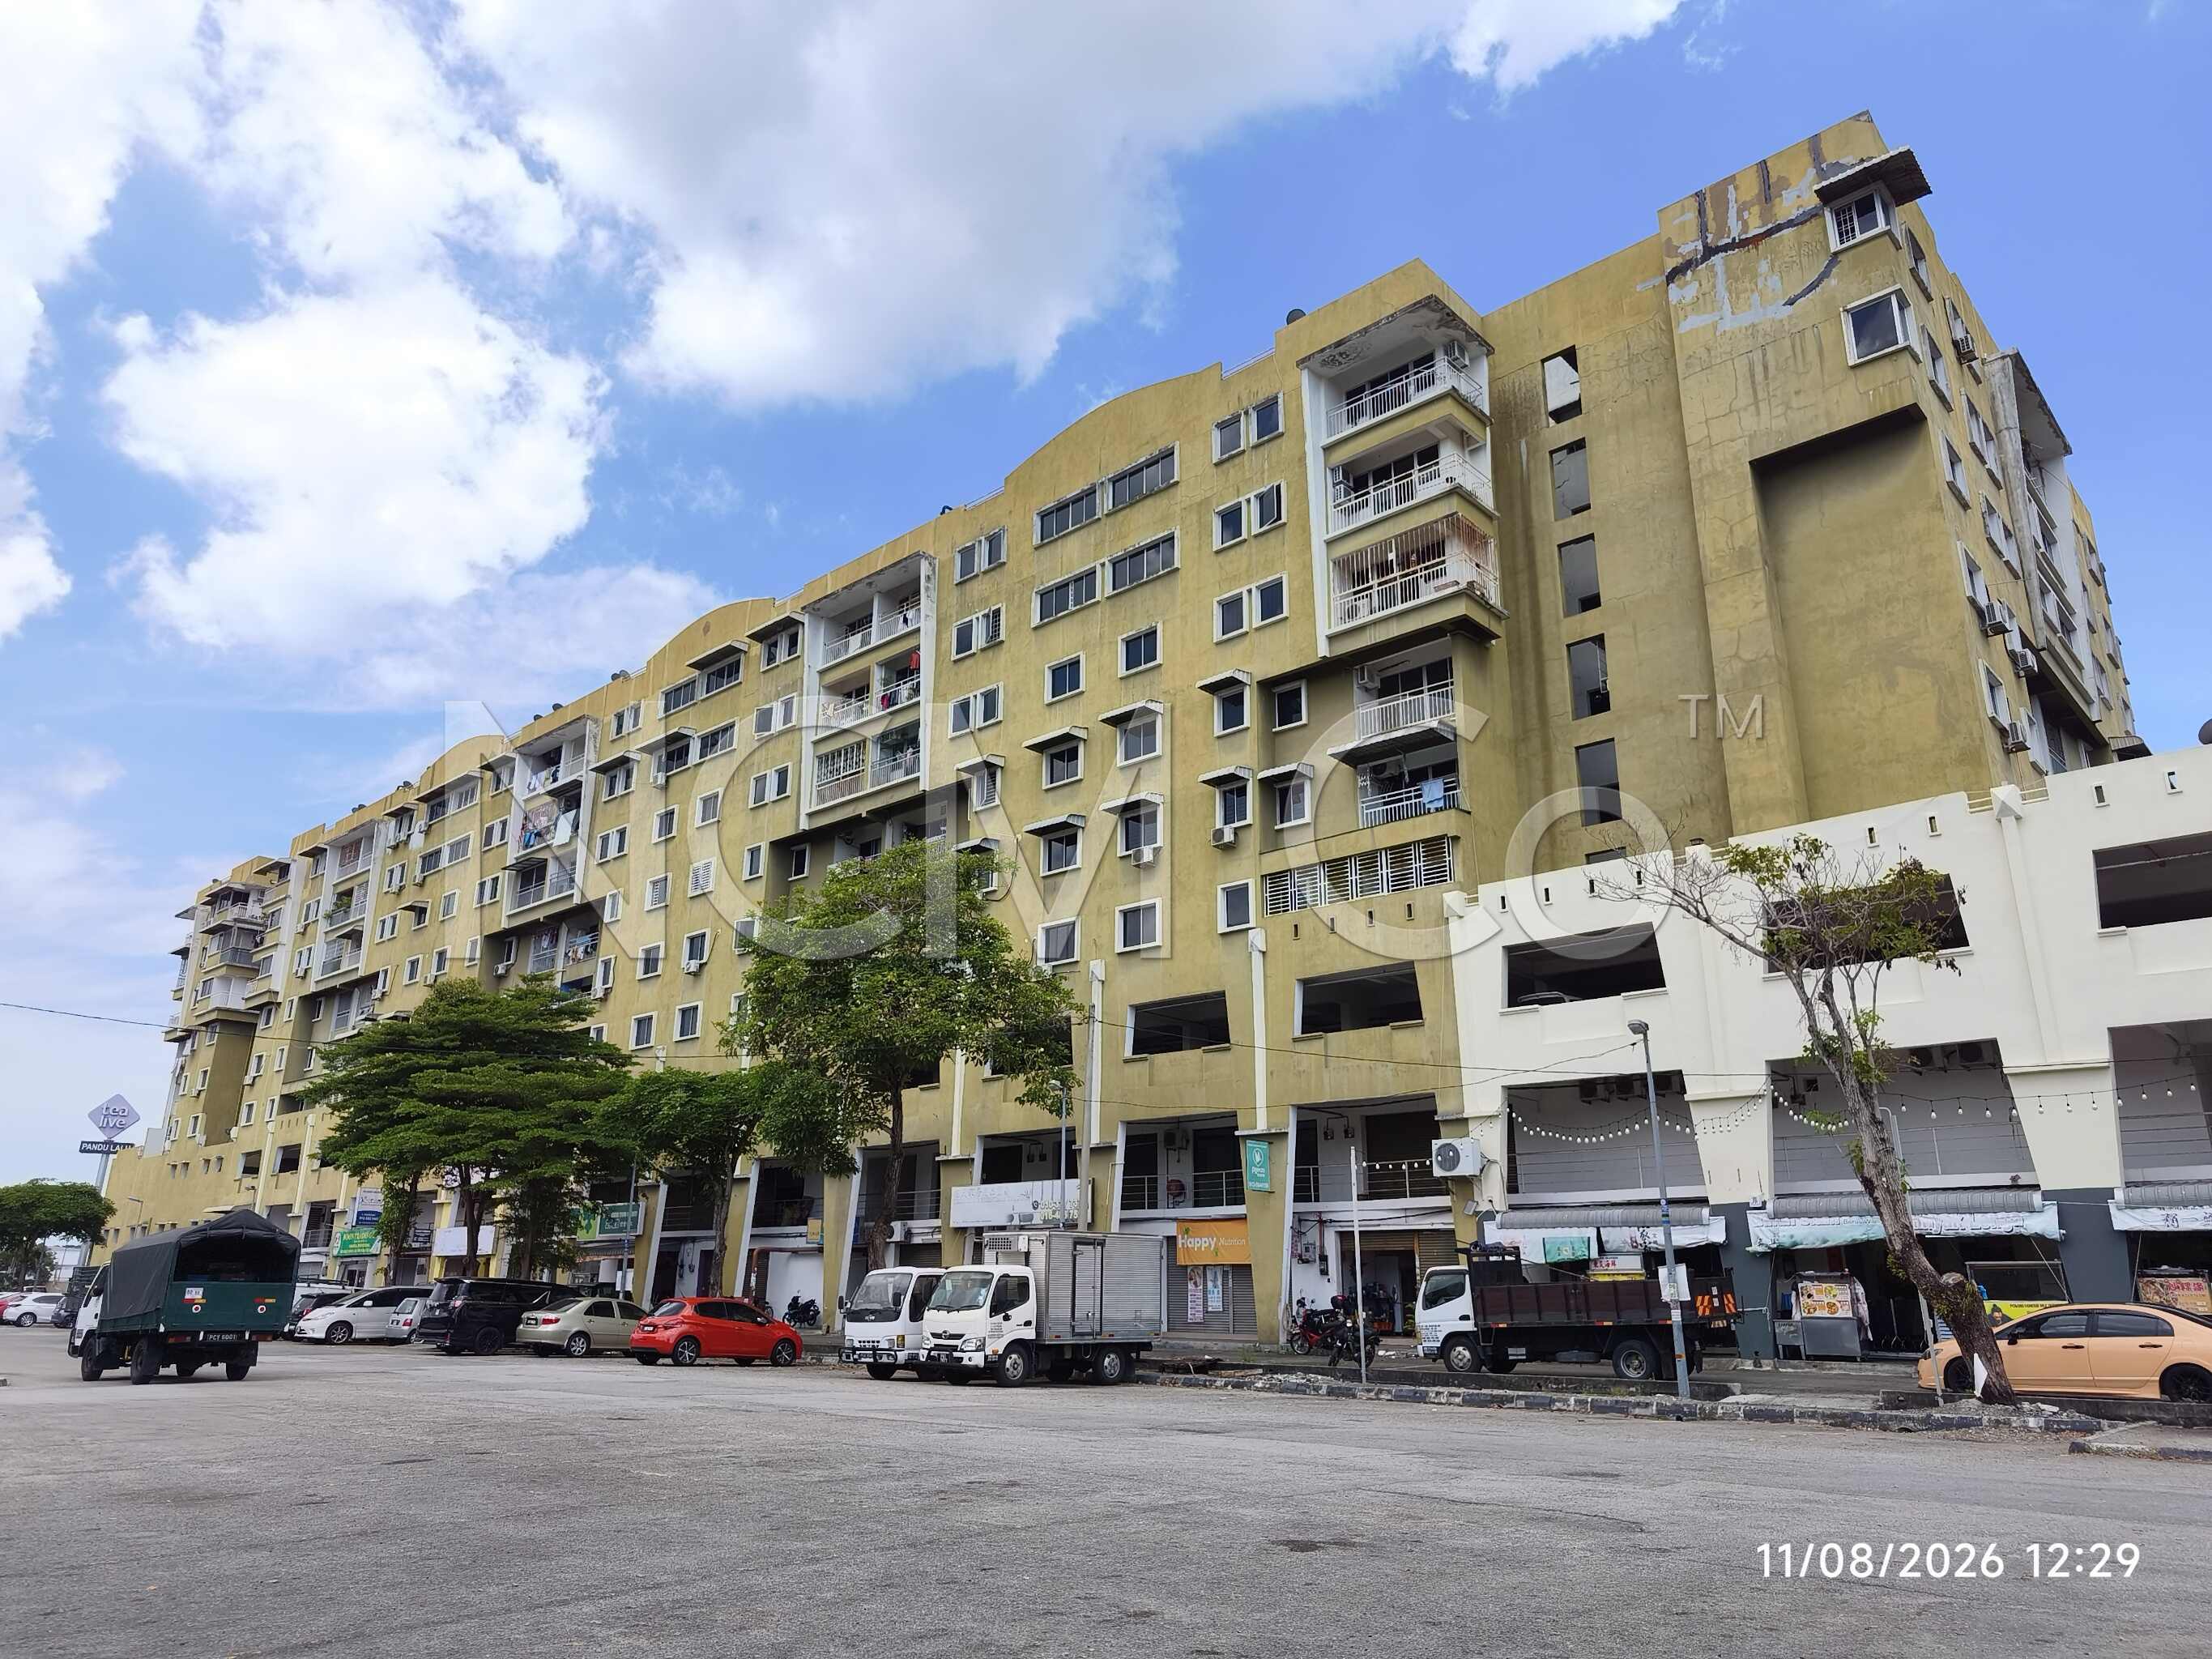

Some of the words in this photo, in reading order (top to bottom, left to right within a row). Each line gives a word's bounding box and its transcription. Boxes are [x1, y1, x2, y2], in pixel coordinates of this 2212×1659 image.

[102, 1102, 129, 1116] tea
[99, 1115, 126, 1128] live
[81, 1143, 109, 1151] PANDU
[1178, 1235, 1217, 1251] Happy
[1218, 1237, 1246, 1246] Nutrition
